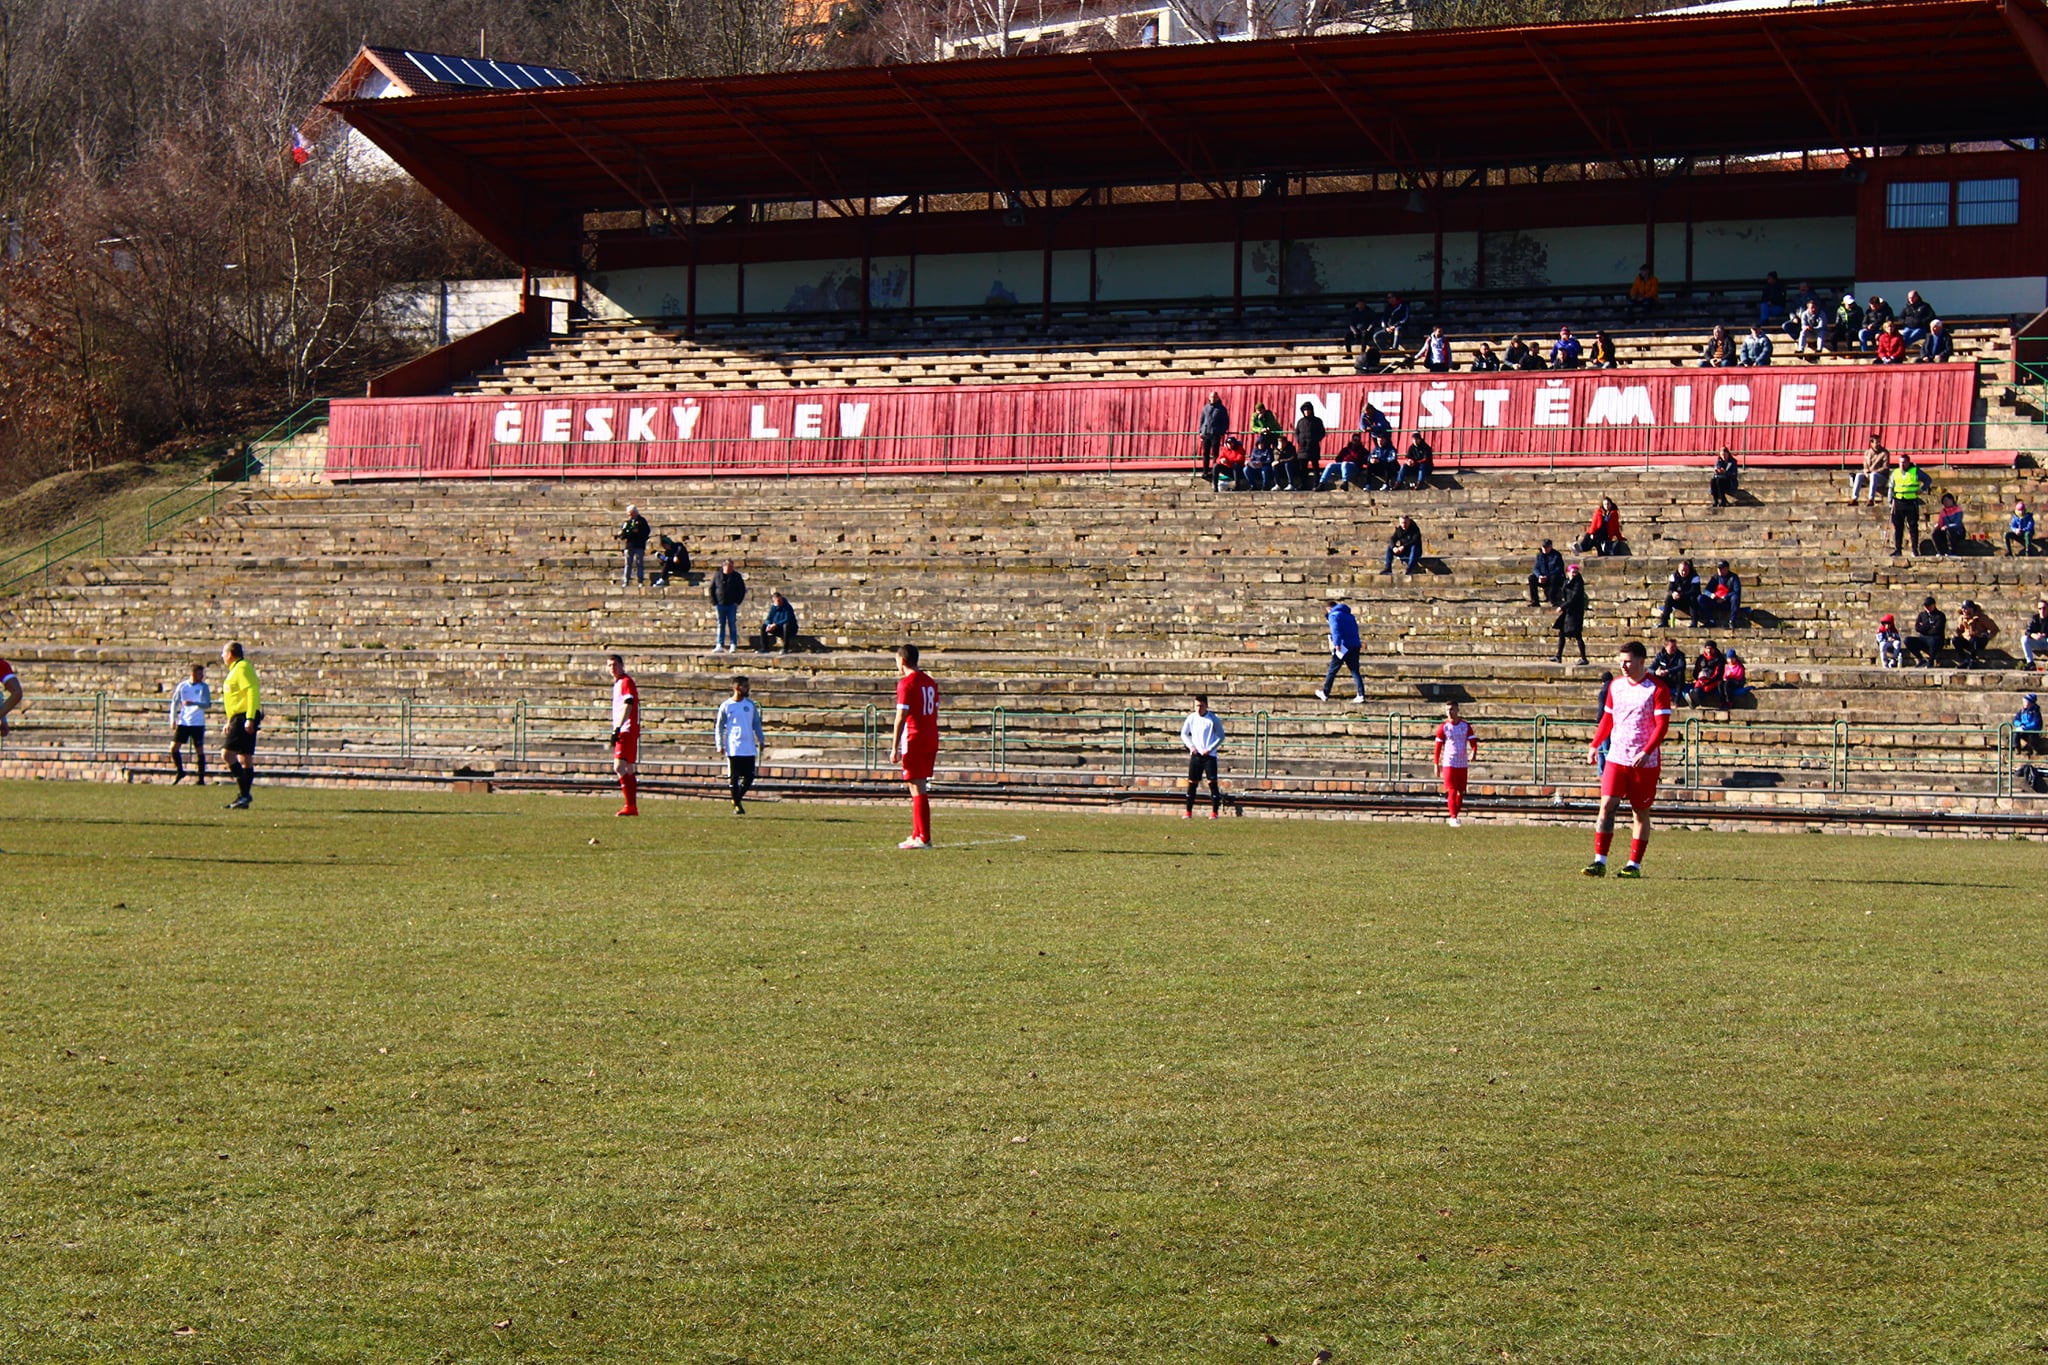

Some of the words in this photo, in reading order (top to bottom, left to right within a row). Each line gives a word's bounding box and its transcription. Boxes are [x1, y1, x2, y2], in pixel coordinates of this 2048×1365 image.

[494, 398, 701, 443] ČESKÝ
[751, 402, 870, 438] LEV
[921, 686, 935, 715] 18
